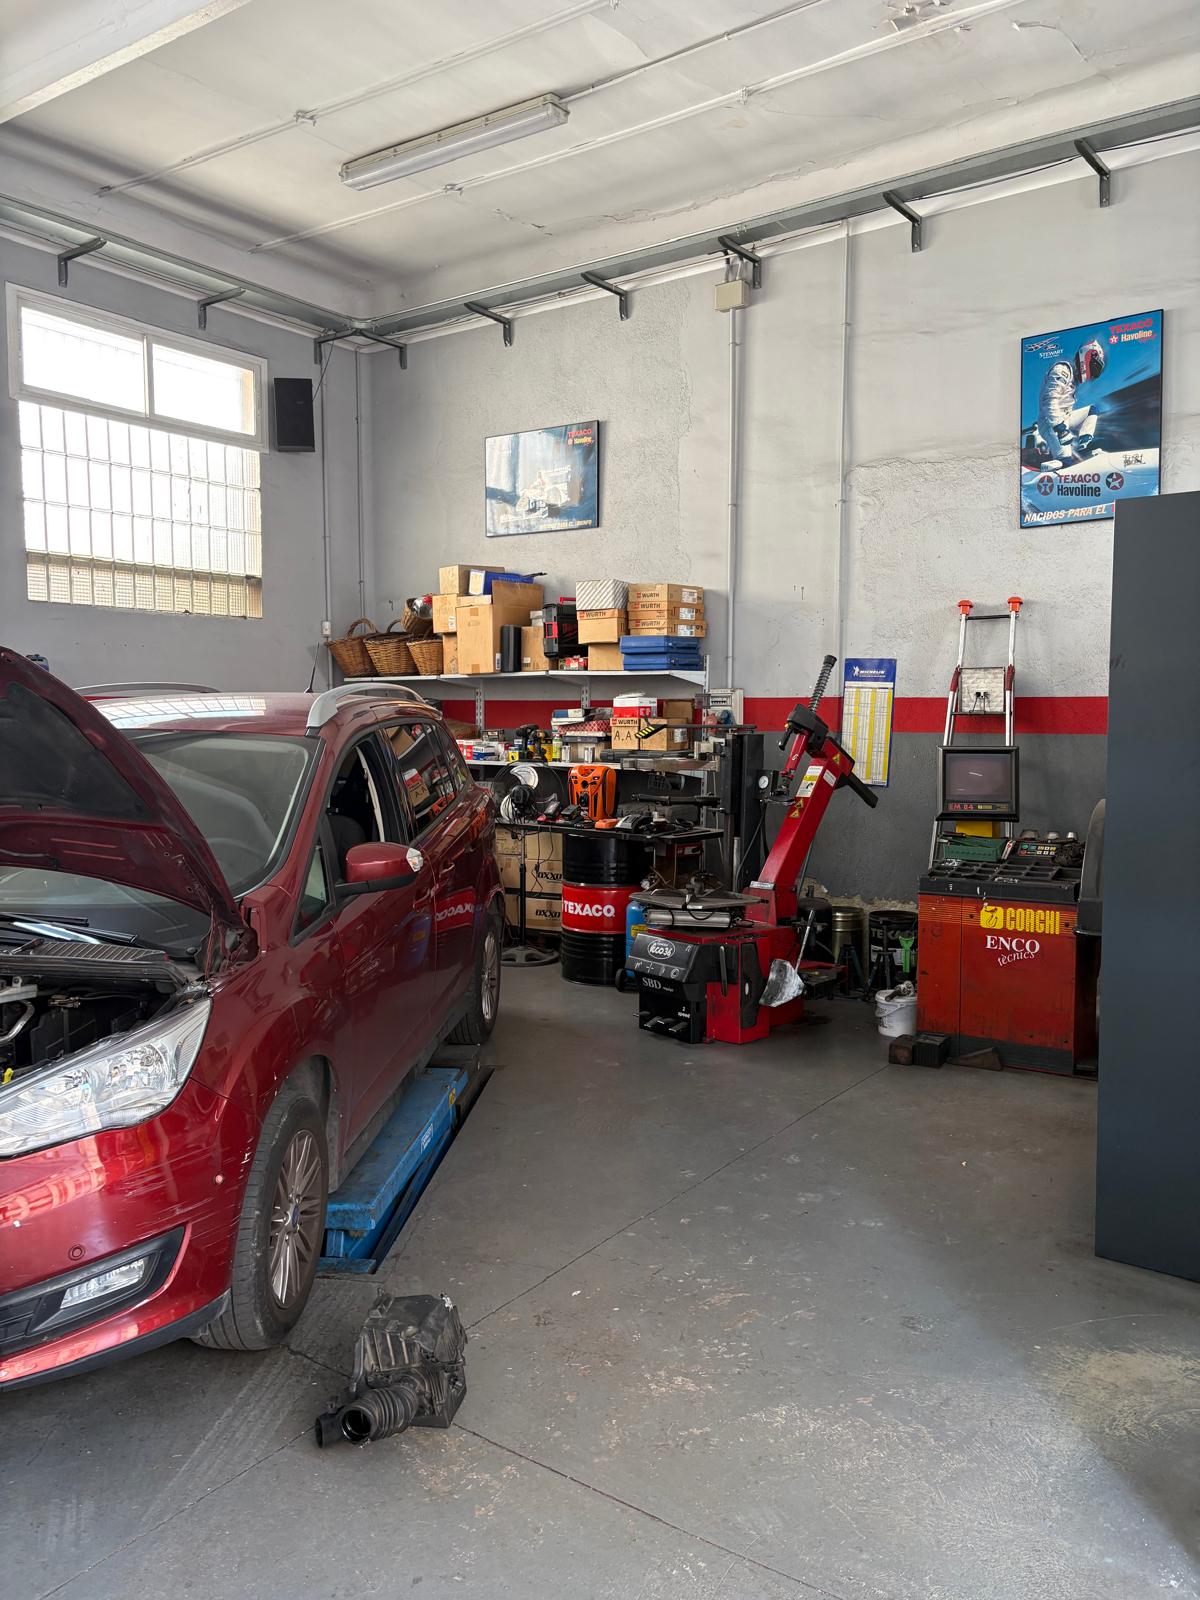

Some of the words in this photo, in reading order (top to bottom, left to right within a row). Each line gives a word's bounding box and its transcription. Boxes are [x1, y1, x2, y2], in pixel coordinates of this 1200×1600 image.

[1109, 318, 1153, 334] TEXACO
[1120, 330, 1153, 342] Havoline
[1039, 349, 1064, 358] STEWART
[1058, 473, 1101, 484] TEXACO
[1056, 484, 1101, 497] Havoline
[1024, 510, 1065, 523] NACIDOS
[1067, 507, 1093, 518] PARA
[1095, 504, 1107, 515] EL
[563, 900, 616, 918] TEXACO
[985, 935, 1040, 954] ENCO
[642, 977, 661, 989] SBD
